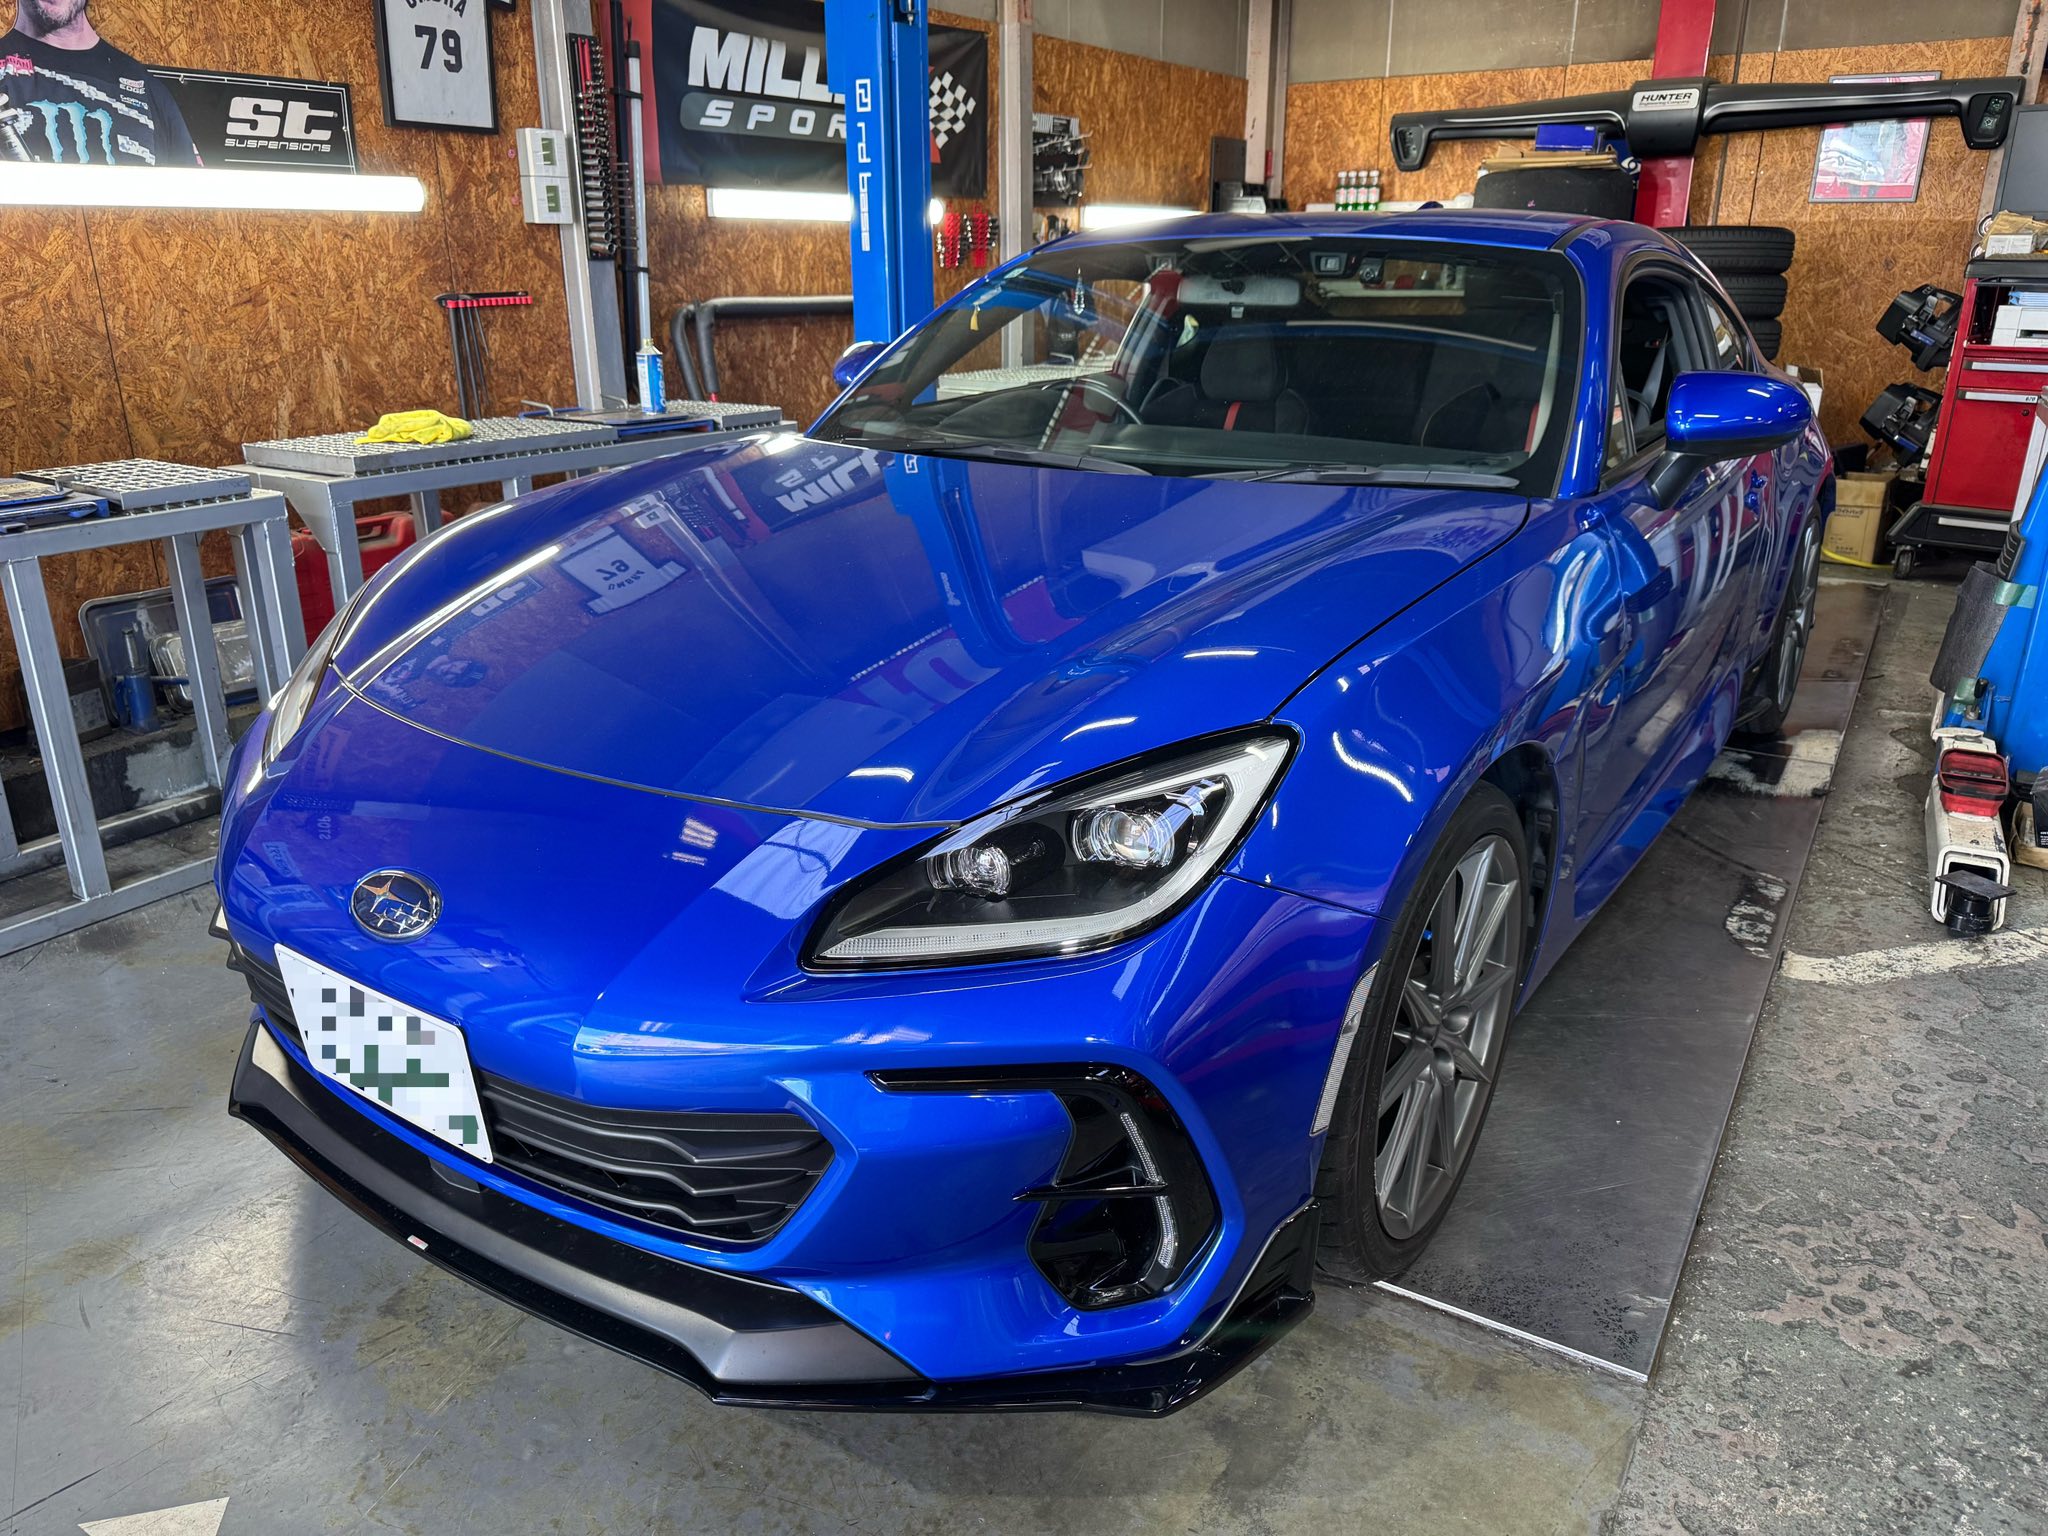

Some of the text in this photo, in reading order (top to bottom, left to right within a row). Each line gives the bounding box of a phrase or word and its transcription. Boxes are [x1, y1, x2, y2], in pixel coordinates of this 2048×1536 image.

[414, 24, 463, 73] 79
[688, 26, 846, 105] MILL
[1641, 92, 1692, 102] HUNTER
[700, 100, 847, 139] SPOR
[224, 138, 331, 152] SUSPENSIONS
